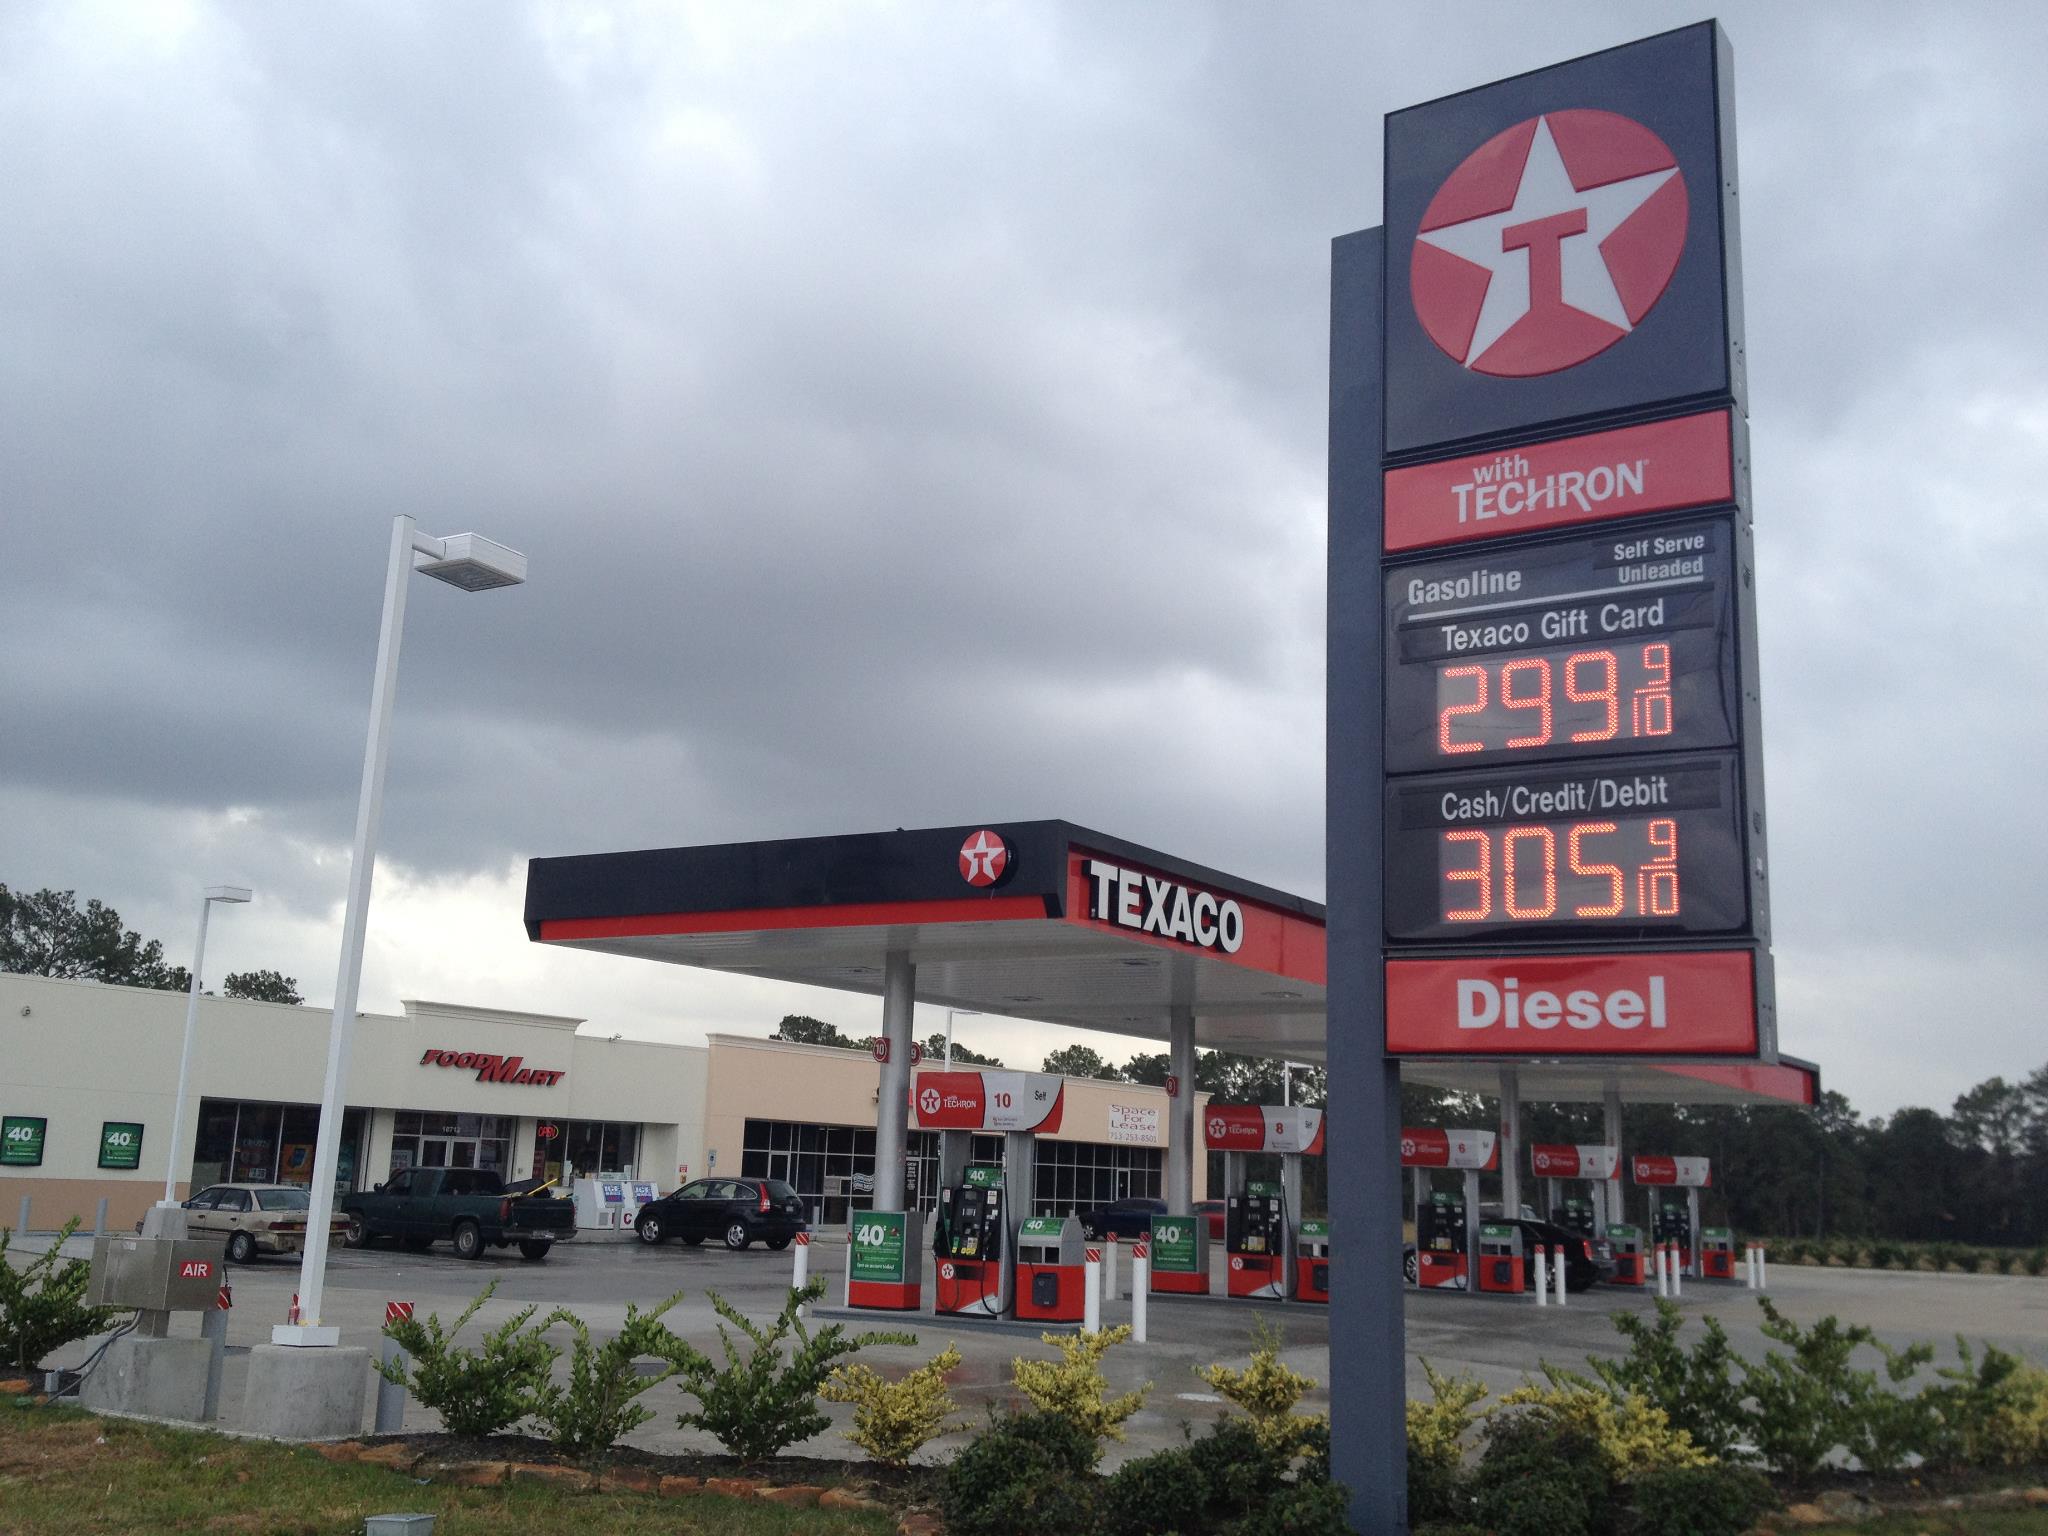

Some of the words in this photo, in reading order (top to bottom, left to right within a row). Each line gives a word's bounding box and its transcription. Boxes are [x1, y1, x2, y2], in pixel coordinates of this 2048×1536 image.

[1473, 455, 1529, 484] with
[1451, 459, 1645, 524] TECHRON
[1614, 540, 1649, 561] Self
[1653, 535, 1705, 555] Serve
[1618, 556, 1704, 584] Unleaded
[1407, 569, 1522, 606] Gasoline
[1442, 621, 1530, 652] Texaco
[1541, 608, 1588, 640] Gift
[1600, 598, 1664, 632] Card
[1439, 650, 1619, 754] 299
[1441, 776, 1668, 821] Cash/Credit/Debit
[1446, 823, 1625, 920] 305
[1090, 859, 1244, 953] TEXACO
[1457, 976, 1666, 1029] Diesel
[875, 1043, 884, 1056] 10
[944, 1099, 977, 1109] TECHRON
[994, 1093, 1011, 1108] 10
[1034, 1090, 1047, 1101] Self
[1112, 1104, 1156, 1116] Space
[1124, 1114, 1145, 1123] For
[538, 1126, 556, 1137] OPEN
[1112, 1120, 1155, 1131] Lease
[1276, 1122, 1284, 1134] 8
[1459, 1144, 1466, 1153] 6
[183, 1263, 208, 1277] AIR
